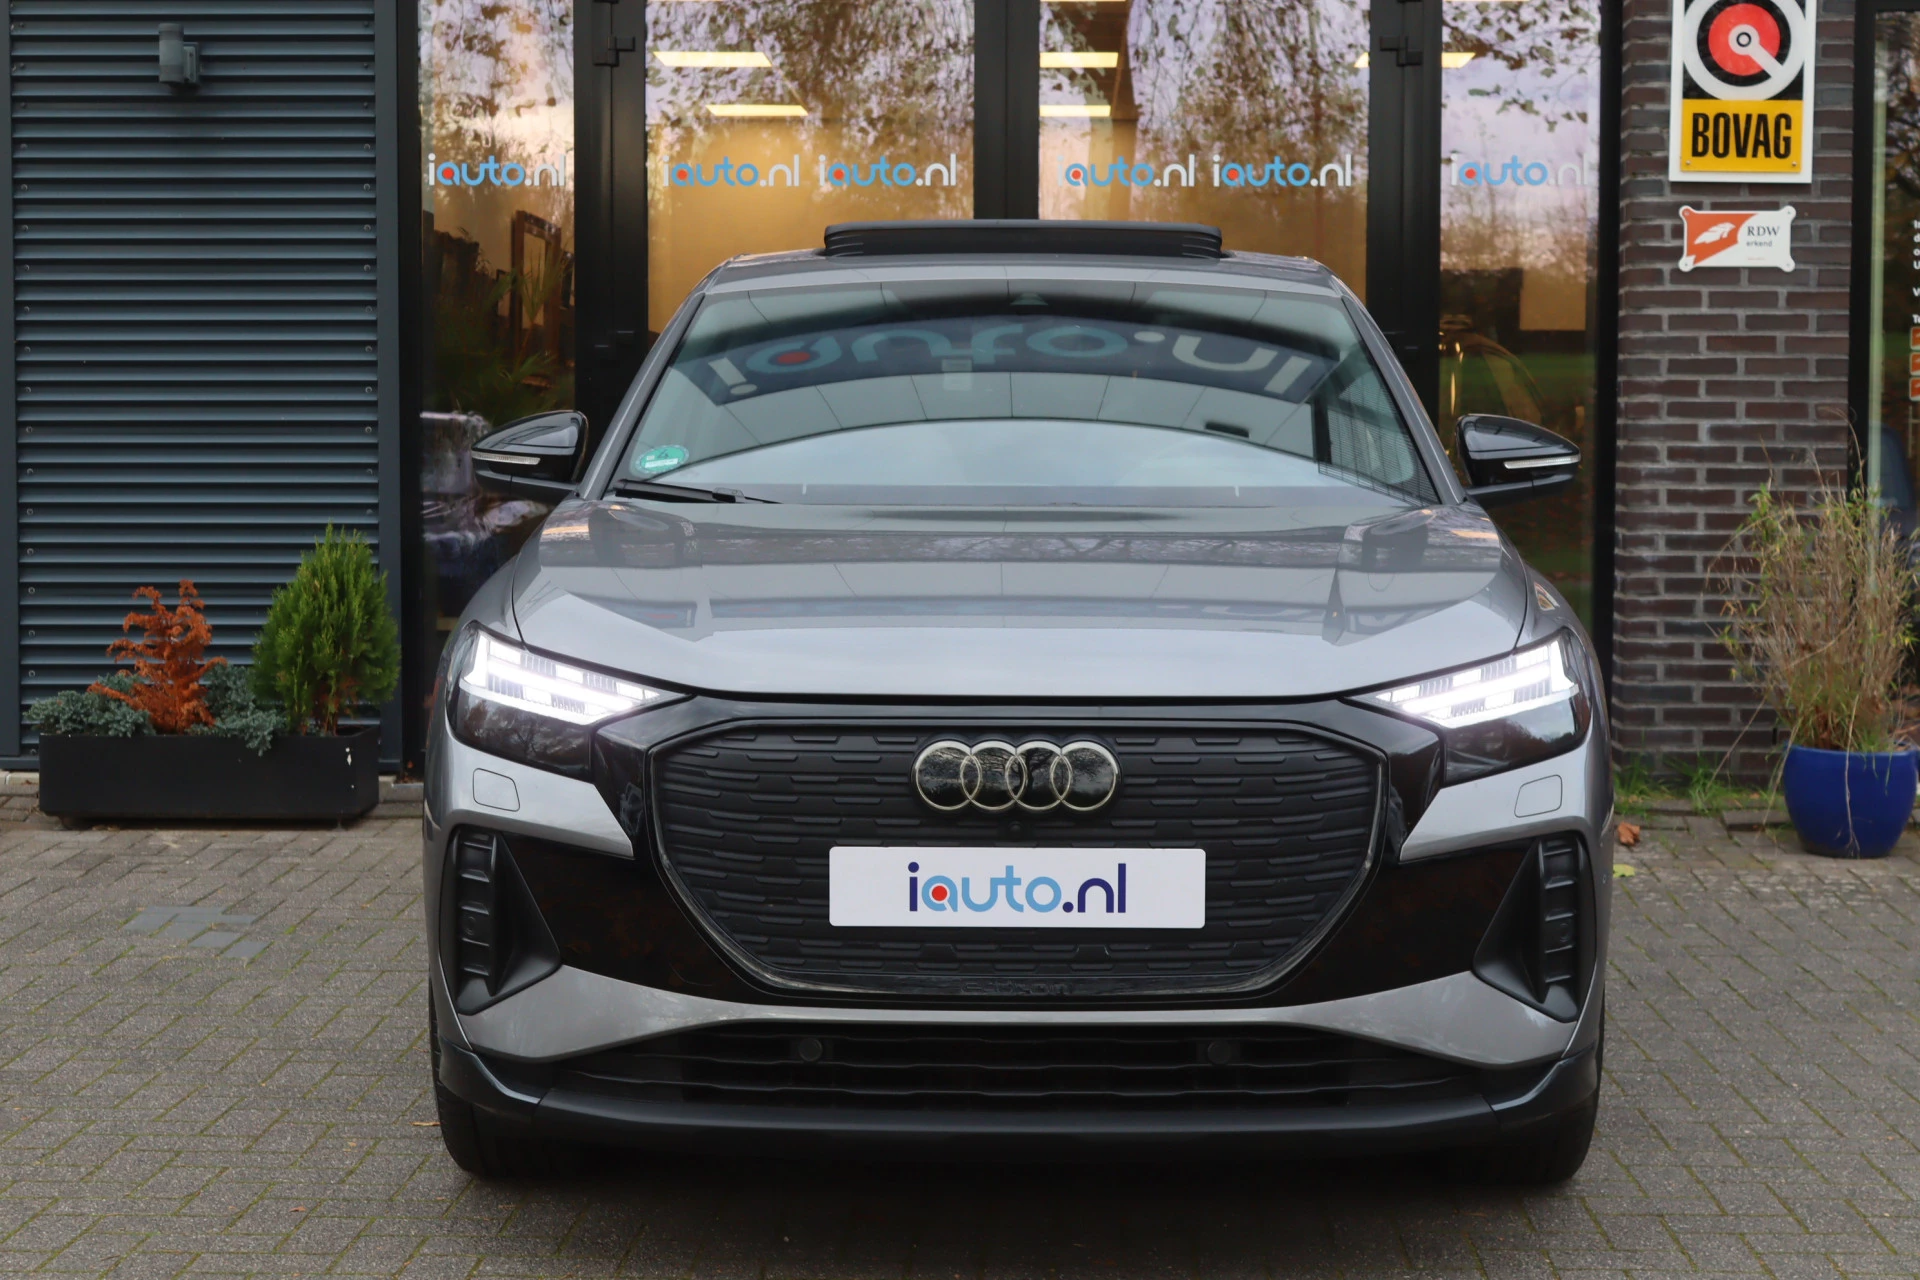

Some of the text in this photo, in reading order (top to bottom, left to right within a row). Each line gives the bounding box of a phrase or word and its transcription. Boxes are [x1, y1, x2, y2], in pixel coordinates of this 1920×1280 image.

[1691, 112, 1792, 159] BOVAG
[428, 153, 566, 187] iauto.nl
[662, 154, 957, 187] iauto.nl iauto.nl
[1057, 153, 1352, 187] iauto.nl iauto.nl
[1450, 153, 1589, 187] iauto.nl
[1746, 240, 1773, 248] erkend
[1747, 226, 1780, 237] RDW
[908, 861, 1127, 914] iauto.nl
